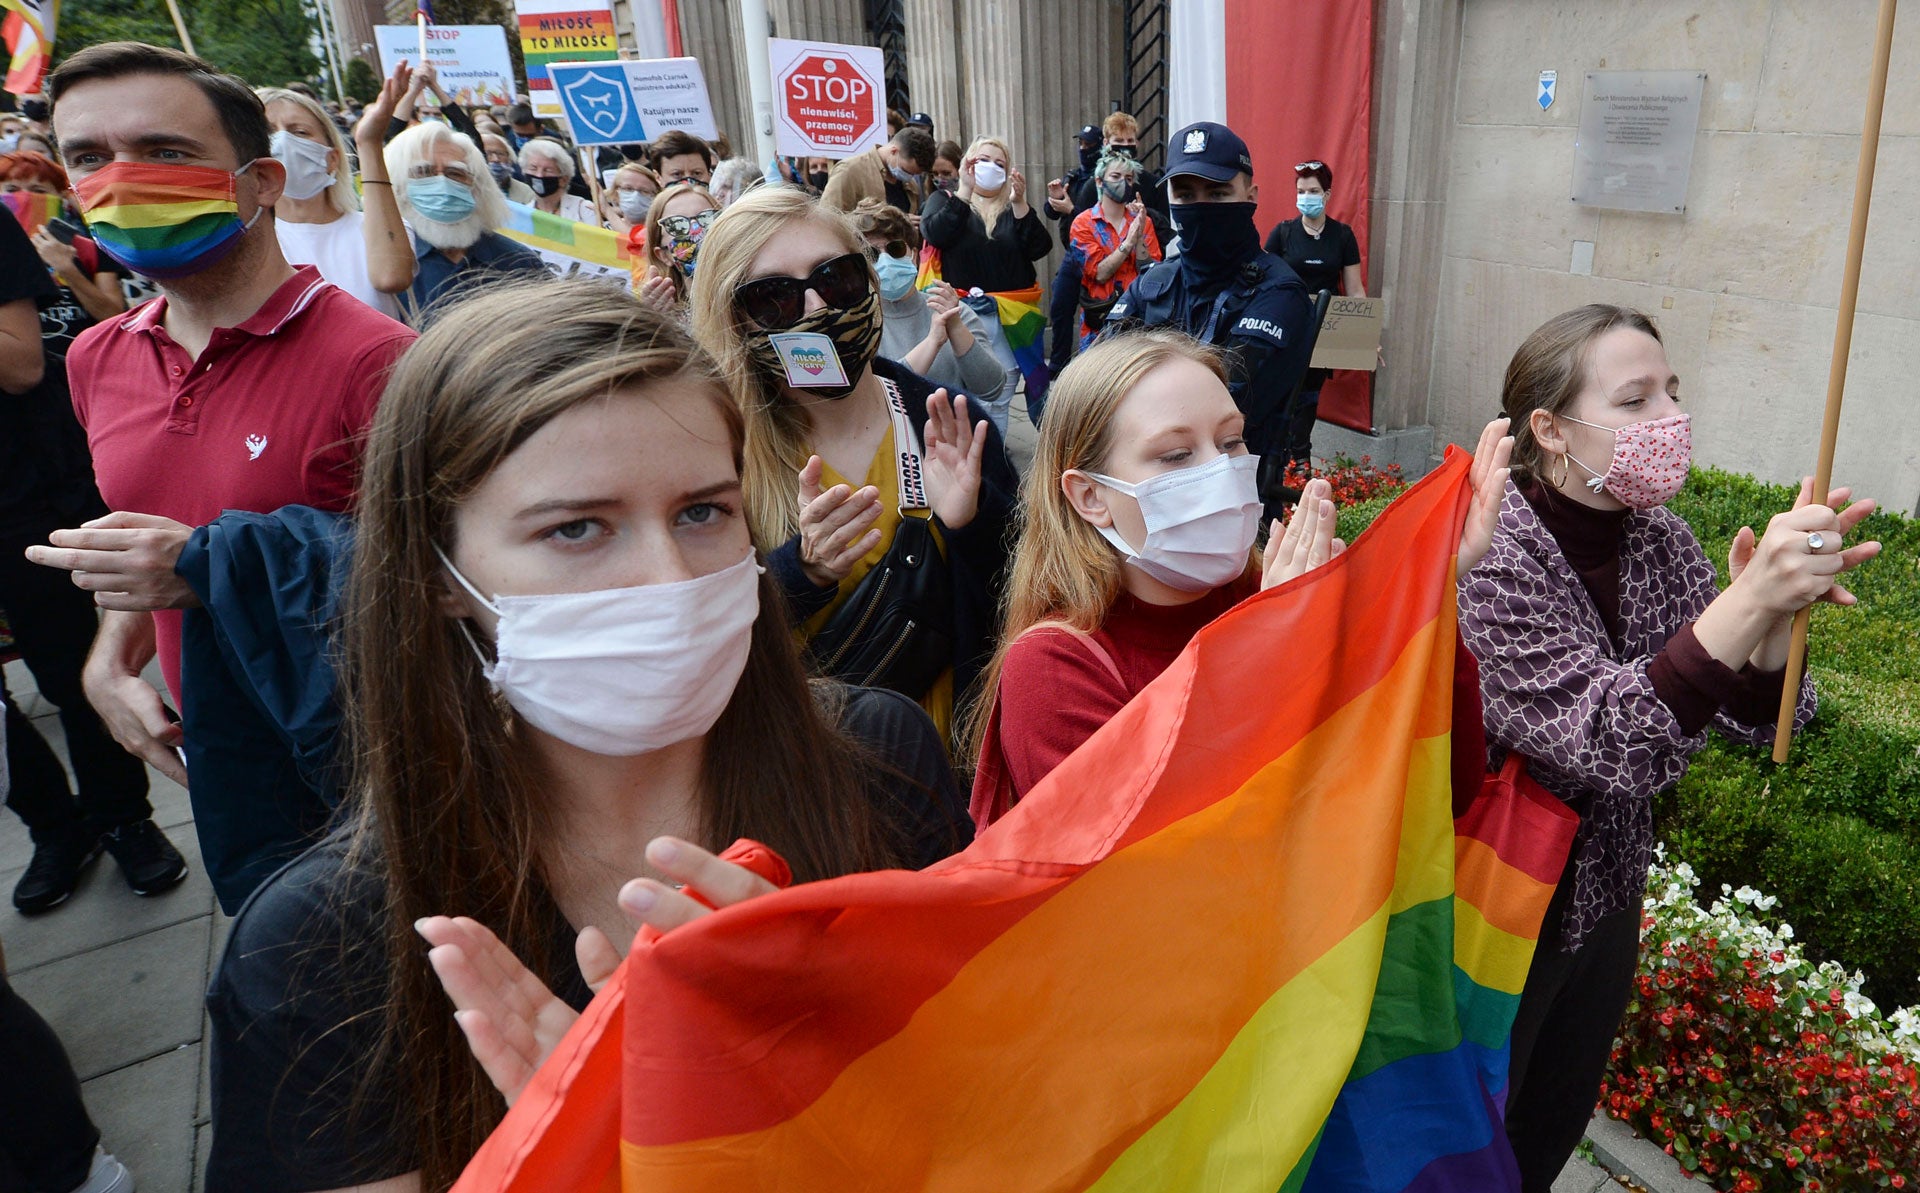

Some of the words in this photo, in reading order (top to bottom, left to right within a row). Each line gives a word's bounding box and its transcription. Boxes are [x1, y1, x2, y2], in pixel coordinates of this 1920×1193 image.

[540, 13, 593, 31] MIŁOŚĆ
[426, 30, 460, 40] STOP
[531, 38, 549, 49] TO
[554, 31, 608, 48] MIŁOŚĆ
[791, 73, 867, 104] STOP
[642, 107, 676, 117] Ratujmy
[676, 106, 700, 114] nasze
[800, 107, 858, 120] nienawiści,
[805, 121, 854, 133] przemocy
[811, 132, 816, 141] i
[818, 134, 853, 145] agresji
[1332, 299, 1374, 315] OBCYCH
[1238, 317, 1283, 340] POLICJA
